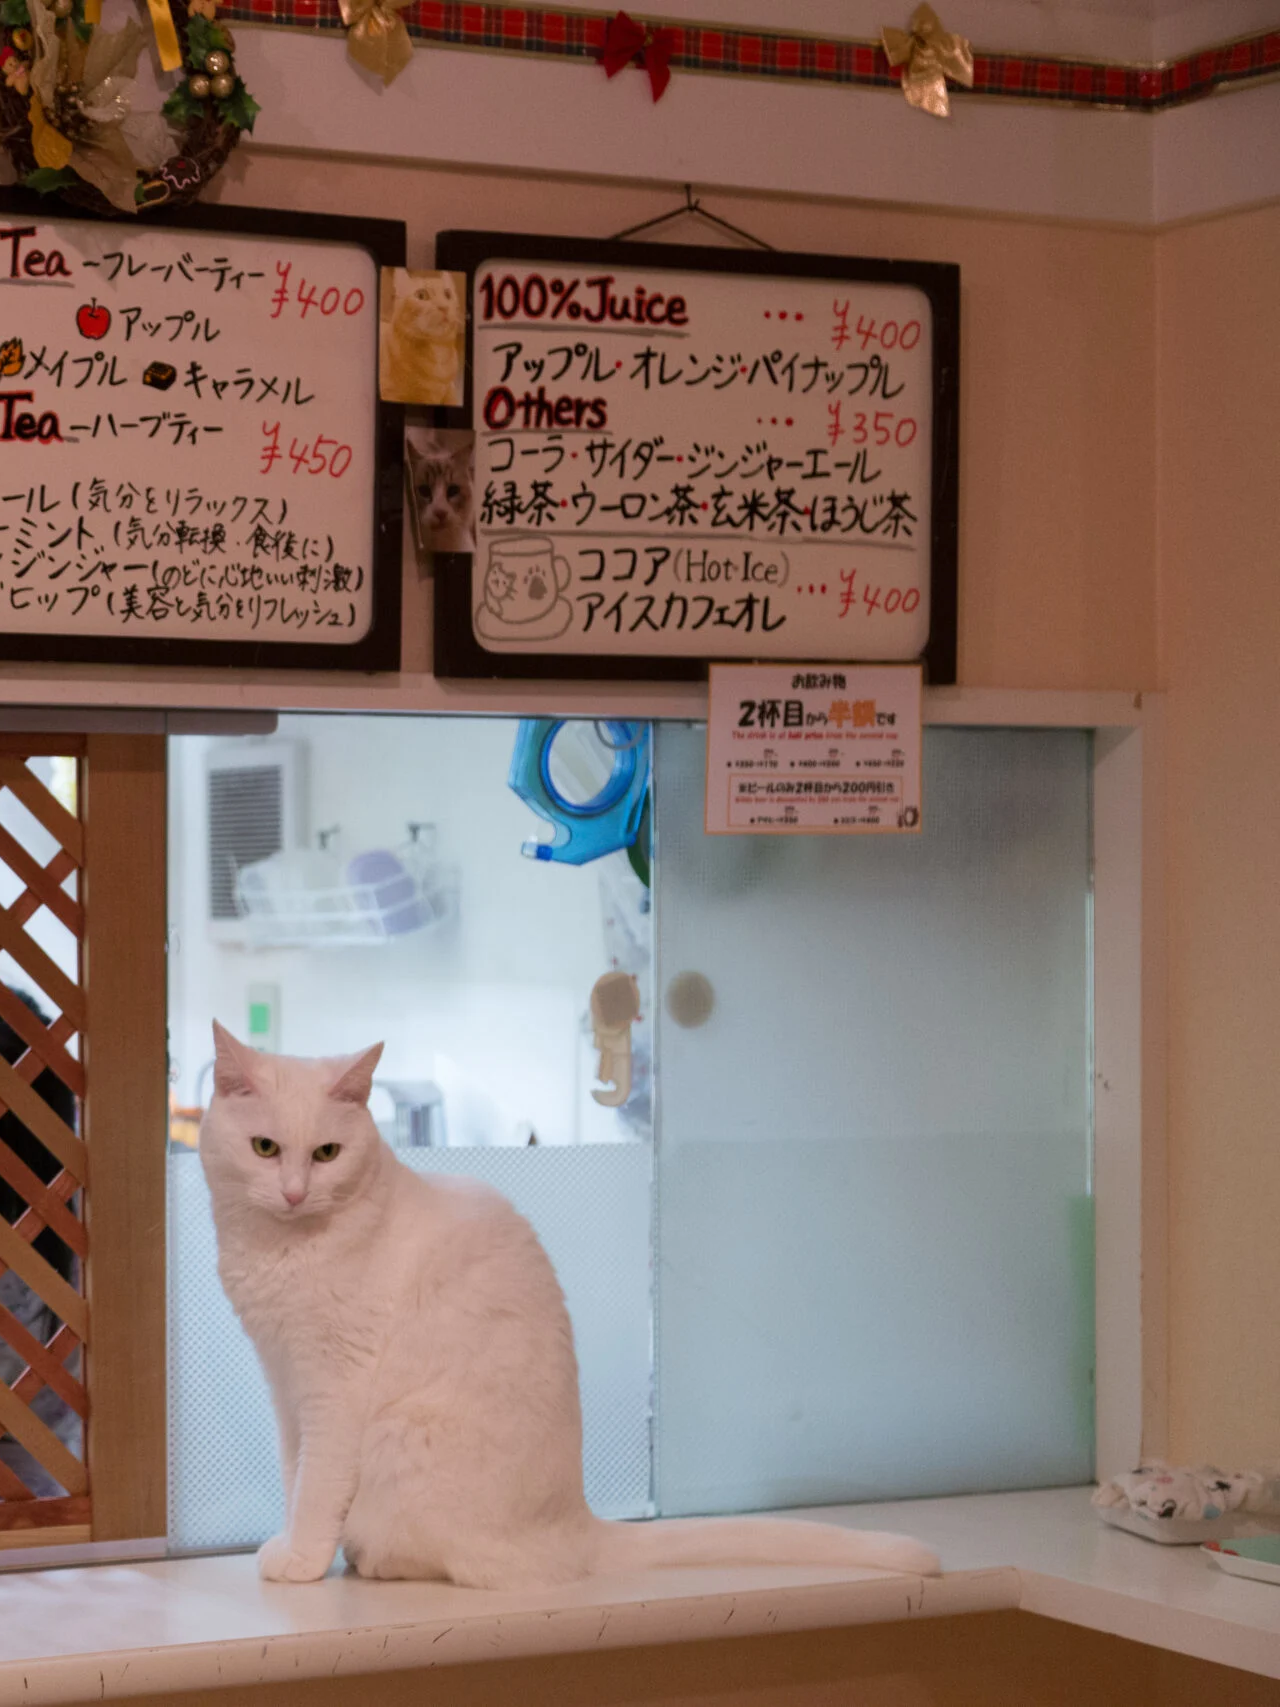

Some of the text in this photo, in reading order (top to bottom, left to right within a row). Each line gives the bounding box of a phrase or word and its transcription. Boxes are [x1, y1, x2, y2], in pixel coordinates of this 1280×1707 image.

[270, 260, 365, 318] ¥400
[120, 307, 220, 342] アップル
[832, 300, 921, 350] ¥400
[24, 346, 127, 389] メイプル
[184, 361, 315, 405] キャラメル
[493, 342, 904, 400] アップル・オレンジ・パイナップル
[483, 385, 607, 430] Others
[828, 400, 917, 447] ¥350
[260, 421, 353, 478] ¥450
[576, 592, 787, 632] アイスカフェオレ
[838, 568, 920, 618] ¥400
[791, 673, 847, 690] お飲み物
[738, 699, 897, 728] 2杯目から半額です
